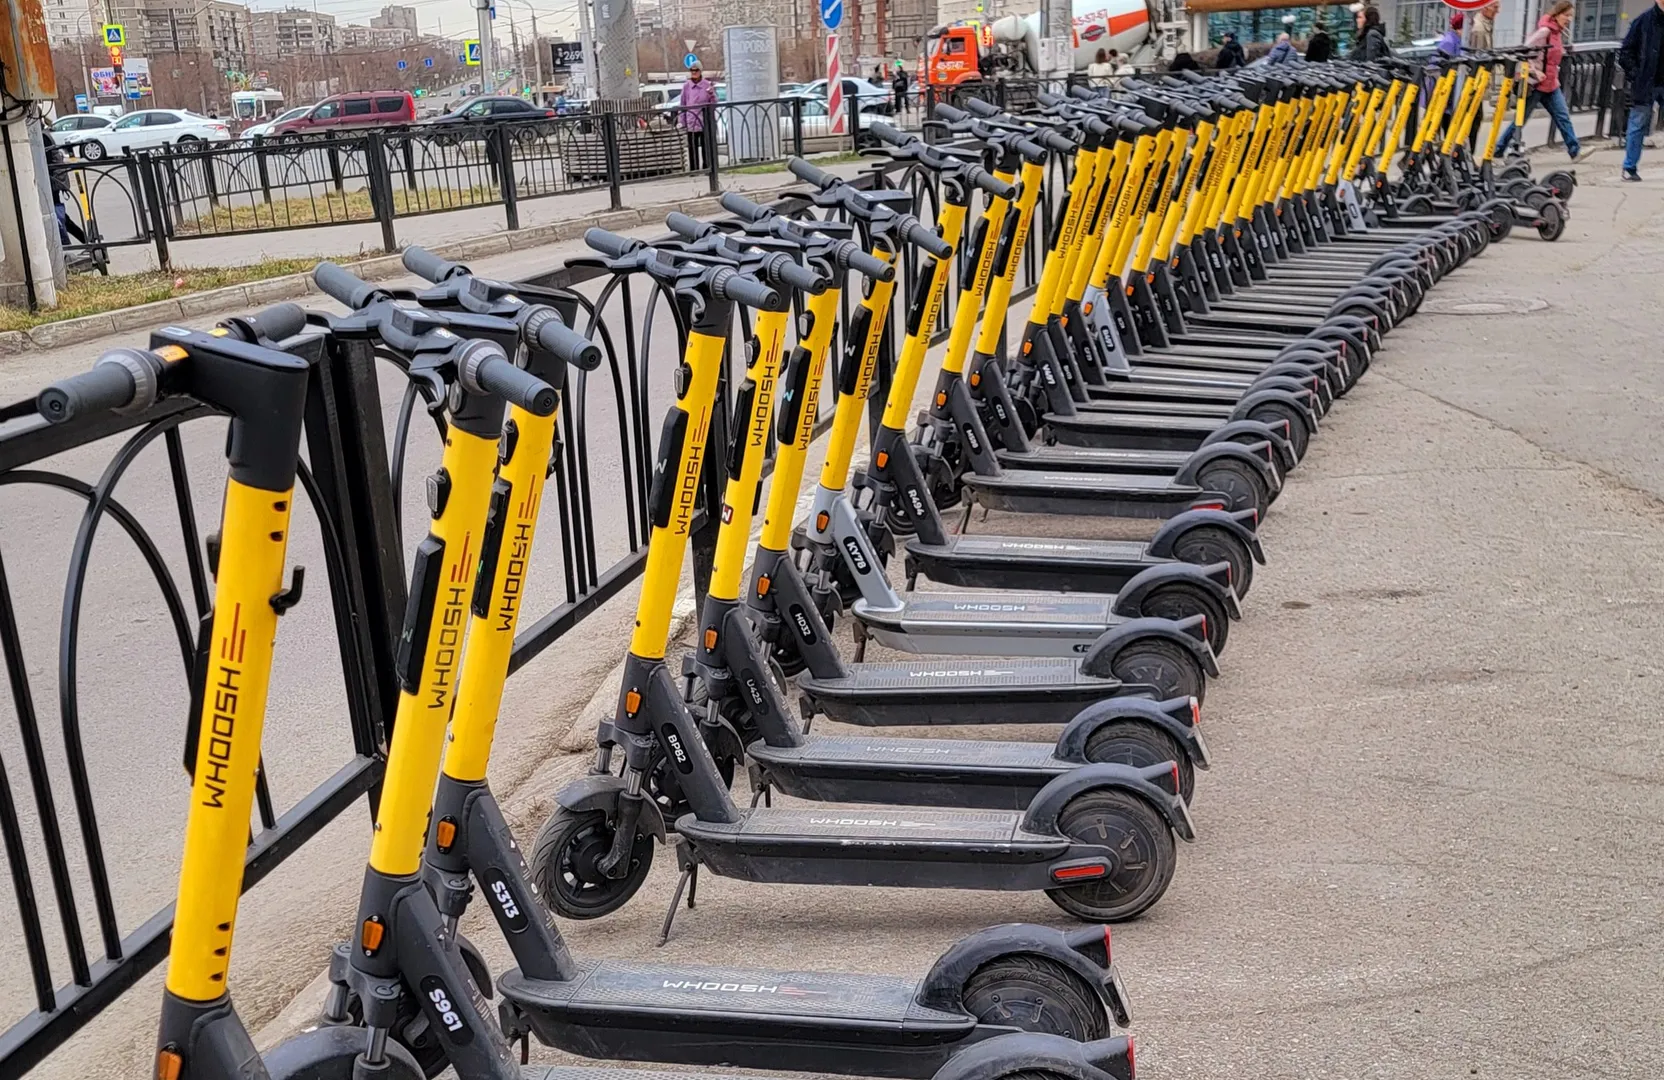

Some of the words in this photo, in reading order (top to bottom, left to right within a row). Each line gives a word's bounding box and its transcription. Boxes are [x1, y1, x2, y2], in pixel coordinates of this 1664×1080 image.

[1097, 196, 1115, 240] WHOOSH
[1113, 184, 1133, 229] WHOOSH
[1137, 178, 1155, 220] WHOOSH
[1158, 177, 1174, 217] WHOOSH
[1058, 204, 1077, 259] WHOOSH
[1076, 204, 1096, 251] WHOOSH
[975, 241, 996, 297] WHOOSH
[1007, 229, 1026, 282] WHOOSH
[921, 283, 945, 345] WHOOSH
[858, 334, 880, 400] WHOOSH
[751, 365, 775, 446] WHOOSH
[798, 378, 819, 451] WHOOSH
[675, 446, 702, 535] WHOOSH
[908, 489, 924, 516] R494
[846, 541, 866, 569] KY78
[1002, 542, 1064, 550] WHOOSH
[496, 523, 531, 631] WHOOSH
[795, 612, 811, 636] HD32
[428, 587, 466, 709] WHOOSH
[746, 679, 762, 705] U425
[910, 669, 982, 677] WHOOSH
[202, 665, 241, 809] WHOOSH
[668, 733, 686, 763] BP82
[866, 745, 950, 754] WHOOSH
[809, 817, 897, 827] WHOOSH
[491, 881, 520, 919] S313
[662, 980, 778, 993] WHOOSH
[428, 988, 463, 1032] S961
